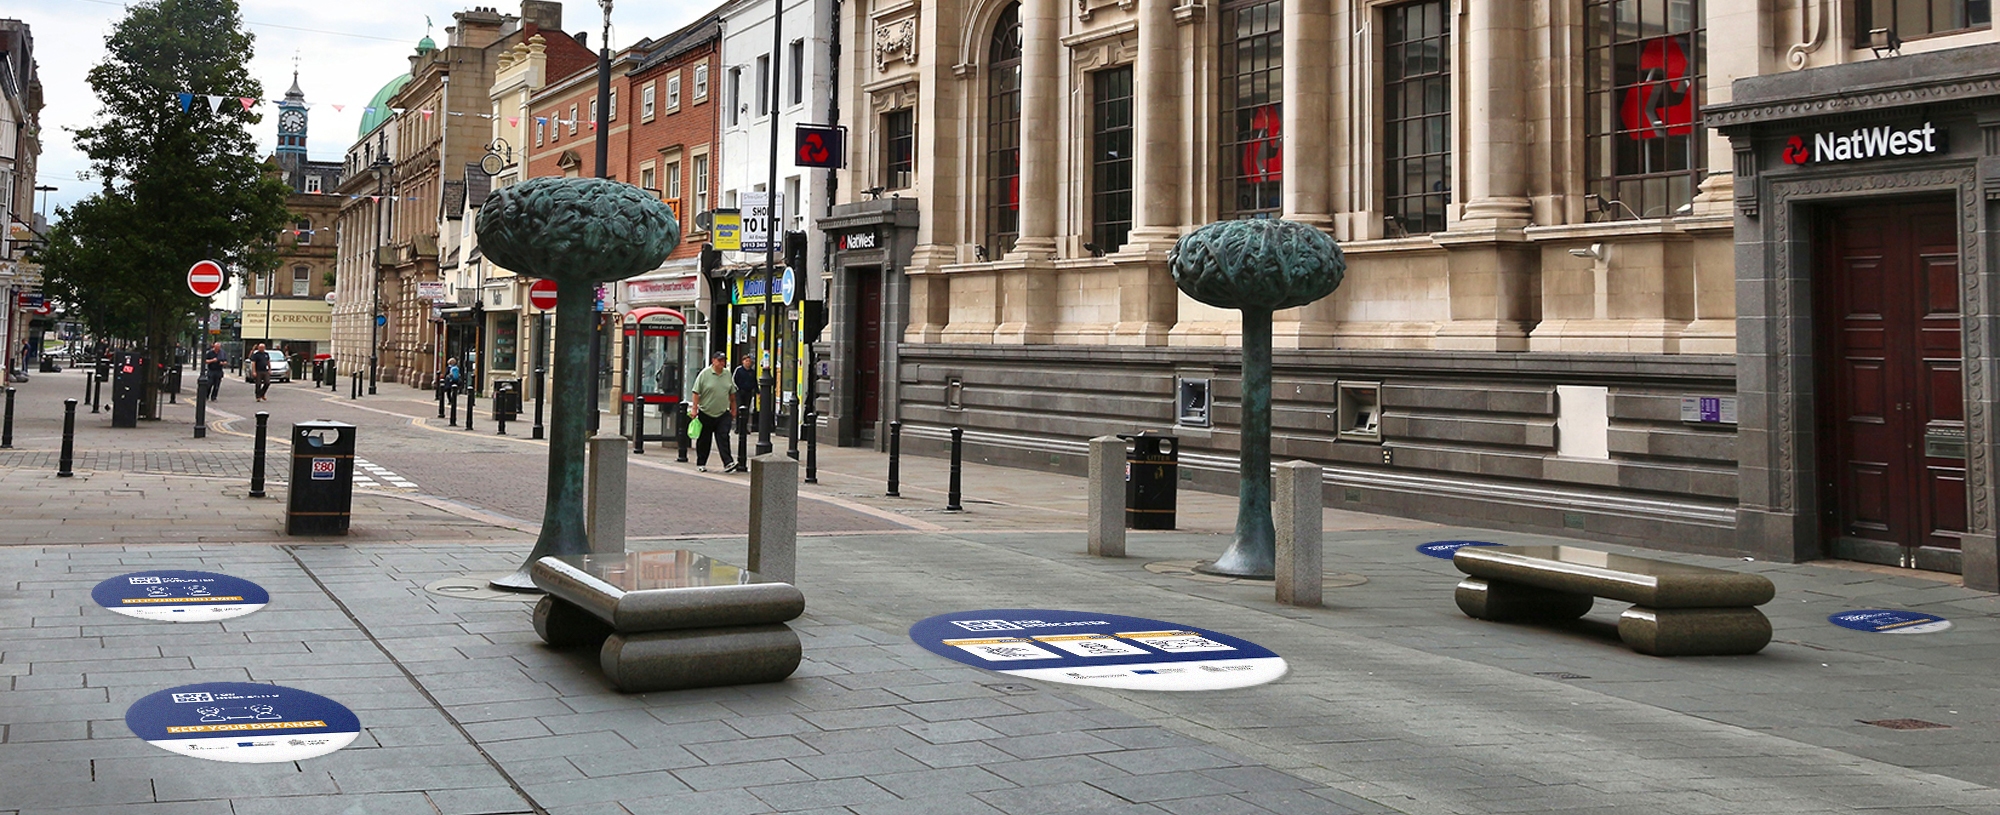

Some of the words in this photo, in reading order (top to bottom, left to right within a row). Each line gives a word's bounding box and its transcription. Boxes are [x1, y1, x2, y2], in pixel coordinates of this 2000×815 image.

[1814, 121, 1936, 163] NatWest
[743, 217, 758, 233] TO
[761, 217, 781, 232] LT
[846, 232, 875, 249] NatWest
[742, 278, 766, 297] Mobil
[283, 315, 323, 324] FRENCH
[313, 461, 335, 472] £80
[210, 723, 249, 731] YOUR
[251, 720, 324, 729] DISTANCE
